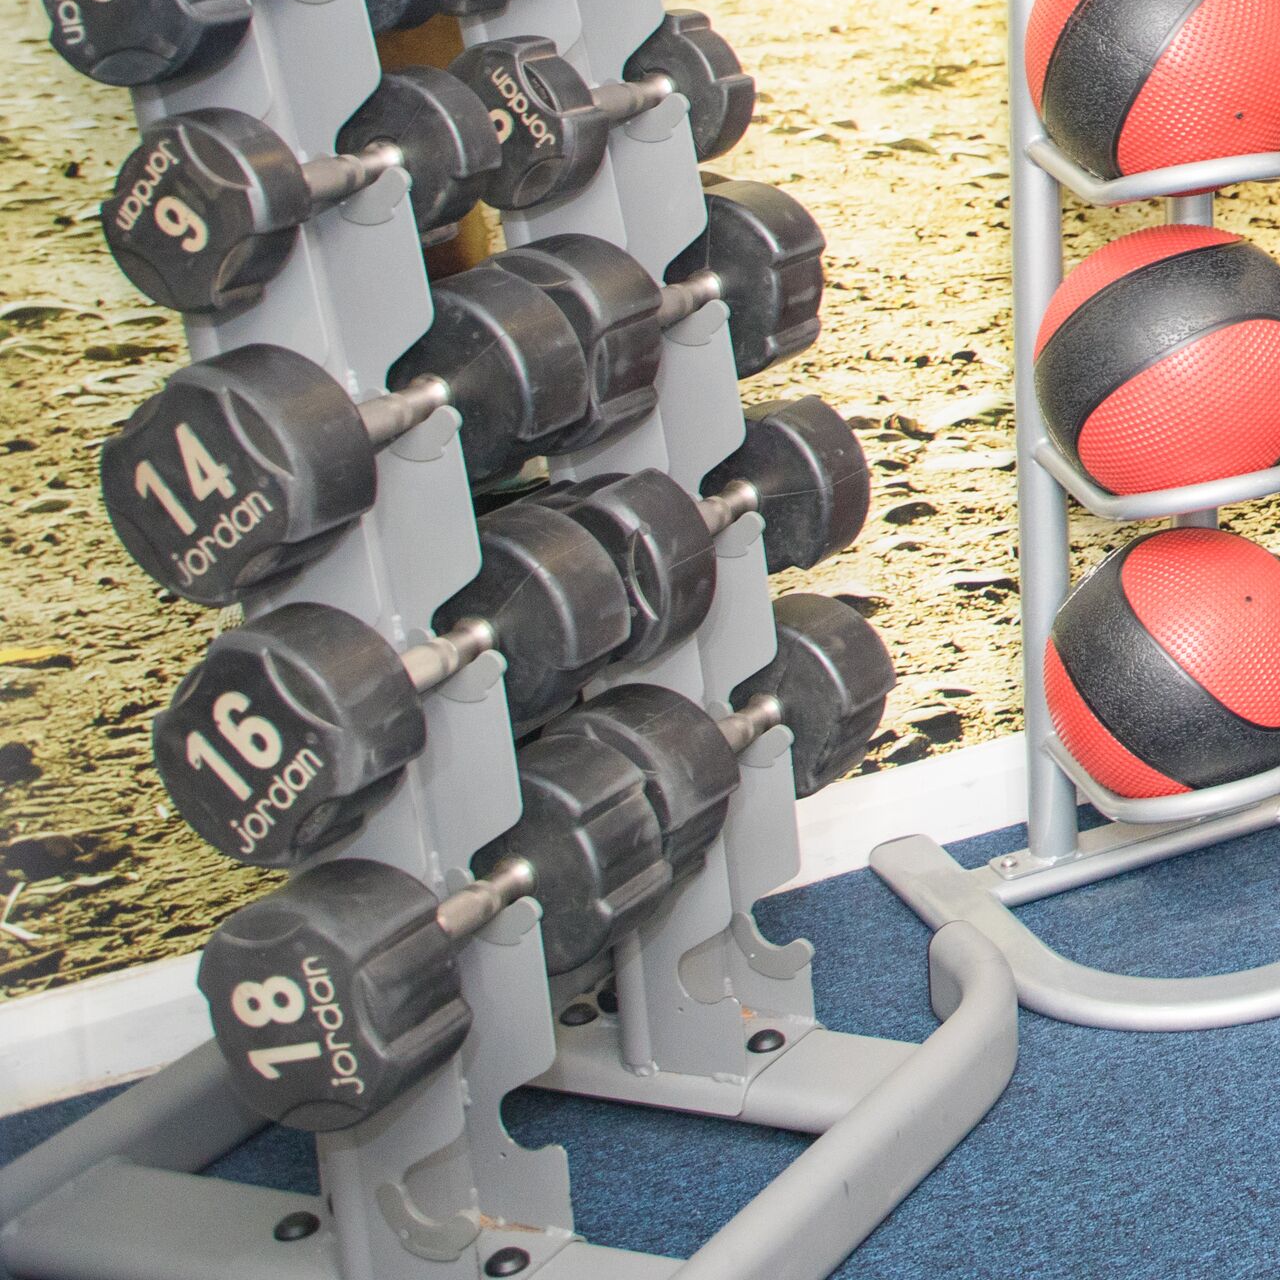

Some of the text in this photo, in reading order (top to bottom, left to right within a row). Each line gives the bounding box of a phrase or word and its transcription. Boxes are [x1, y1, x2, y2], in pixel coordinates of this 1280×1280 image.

[489, 65, 558, 150] jordan
[115, 137, 181, 232] jordan
[134, 421, 236, 538] 14
[171, 488, 274, 587] jordan
[186, 690, 283, 801] 16
[238, 746, 325, 854] jordan
[231, 974, 323, 1081] 18
[304, 955, 366, 1095] jordan
